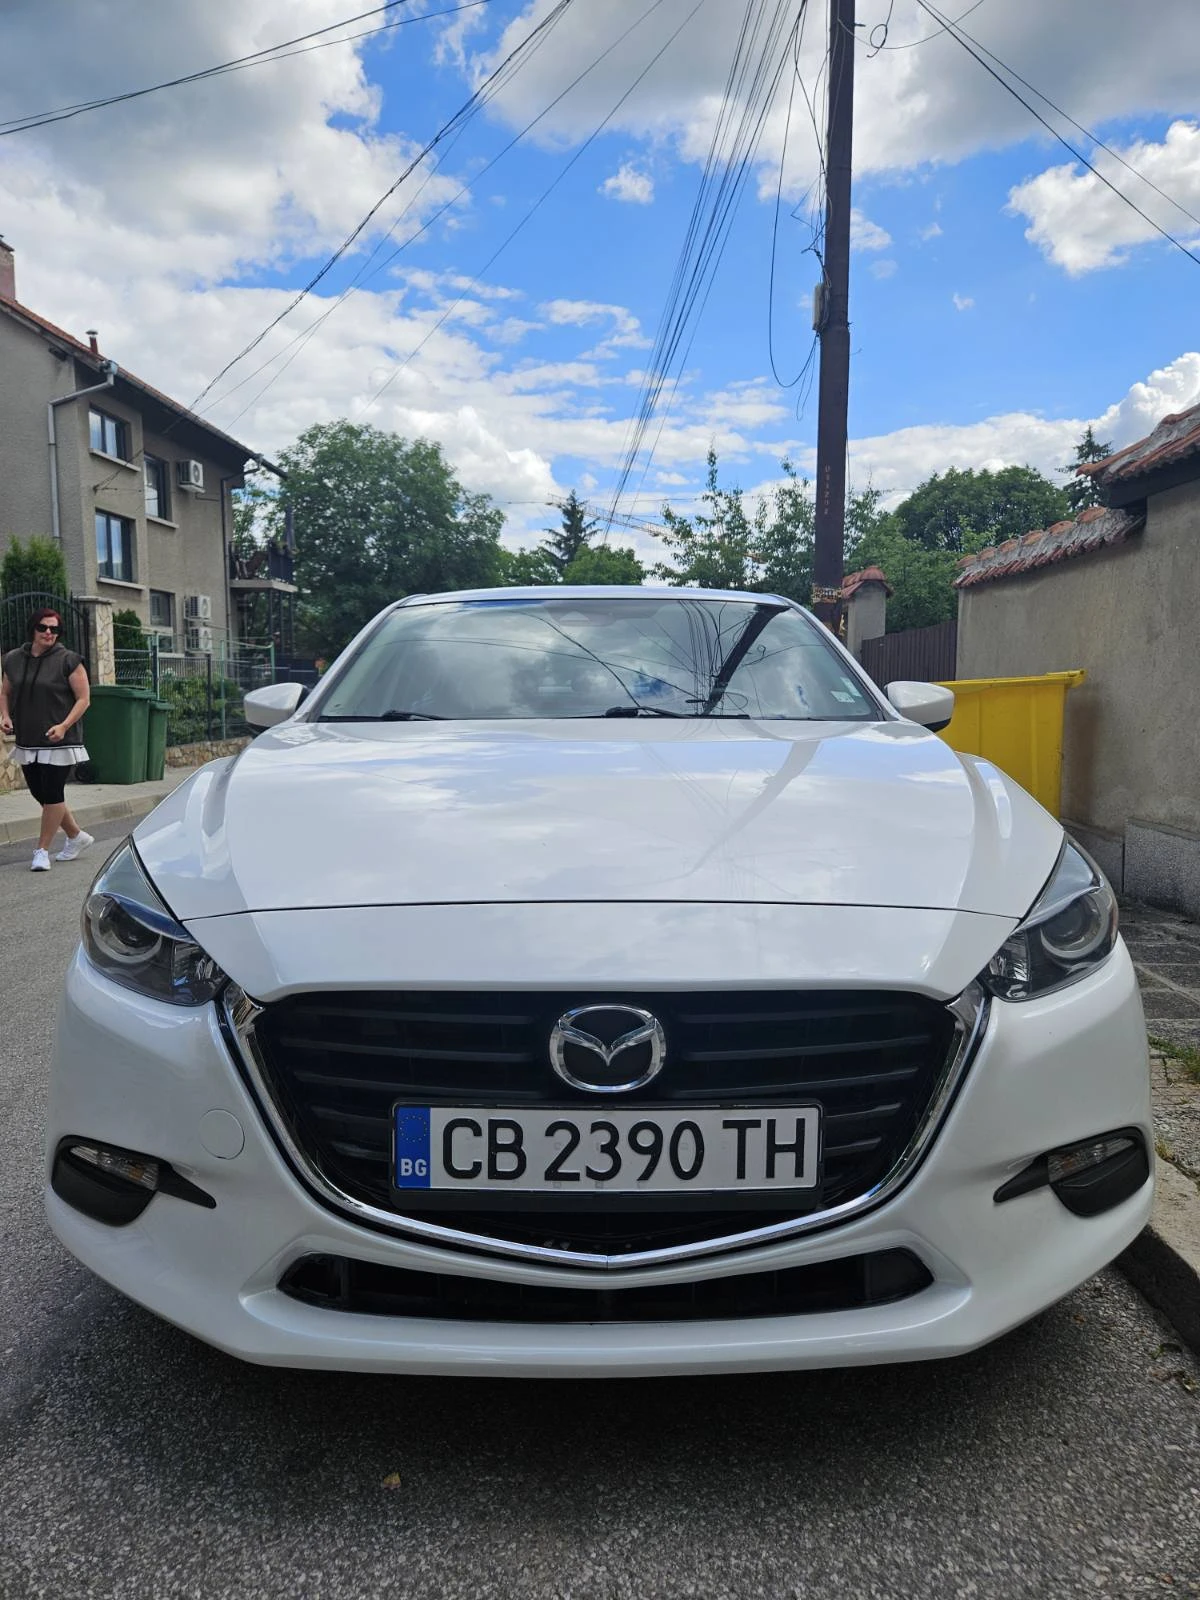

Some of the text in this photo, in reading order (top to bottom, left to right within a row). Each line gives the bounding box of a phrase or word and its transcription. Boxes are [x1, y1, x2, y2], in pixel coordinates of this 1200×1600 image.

[400, 1158, 428, 1177] BG
[443, 1117, 807, 1183] CB 2390 TH
